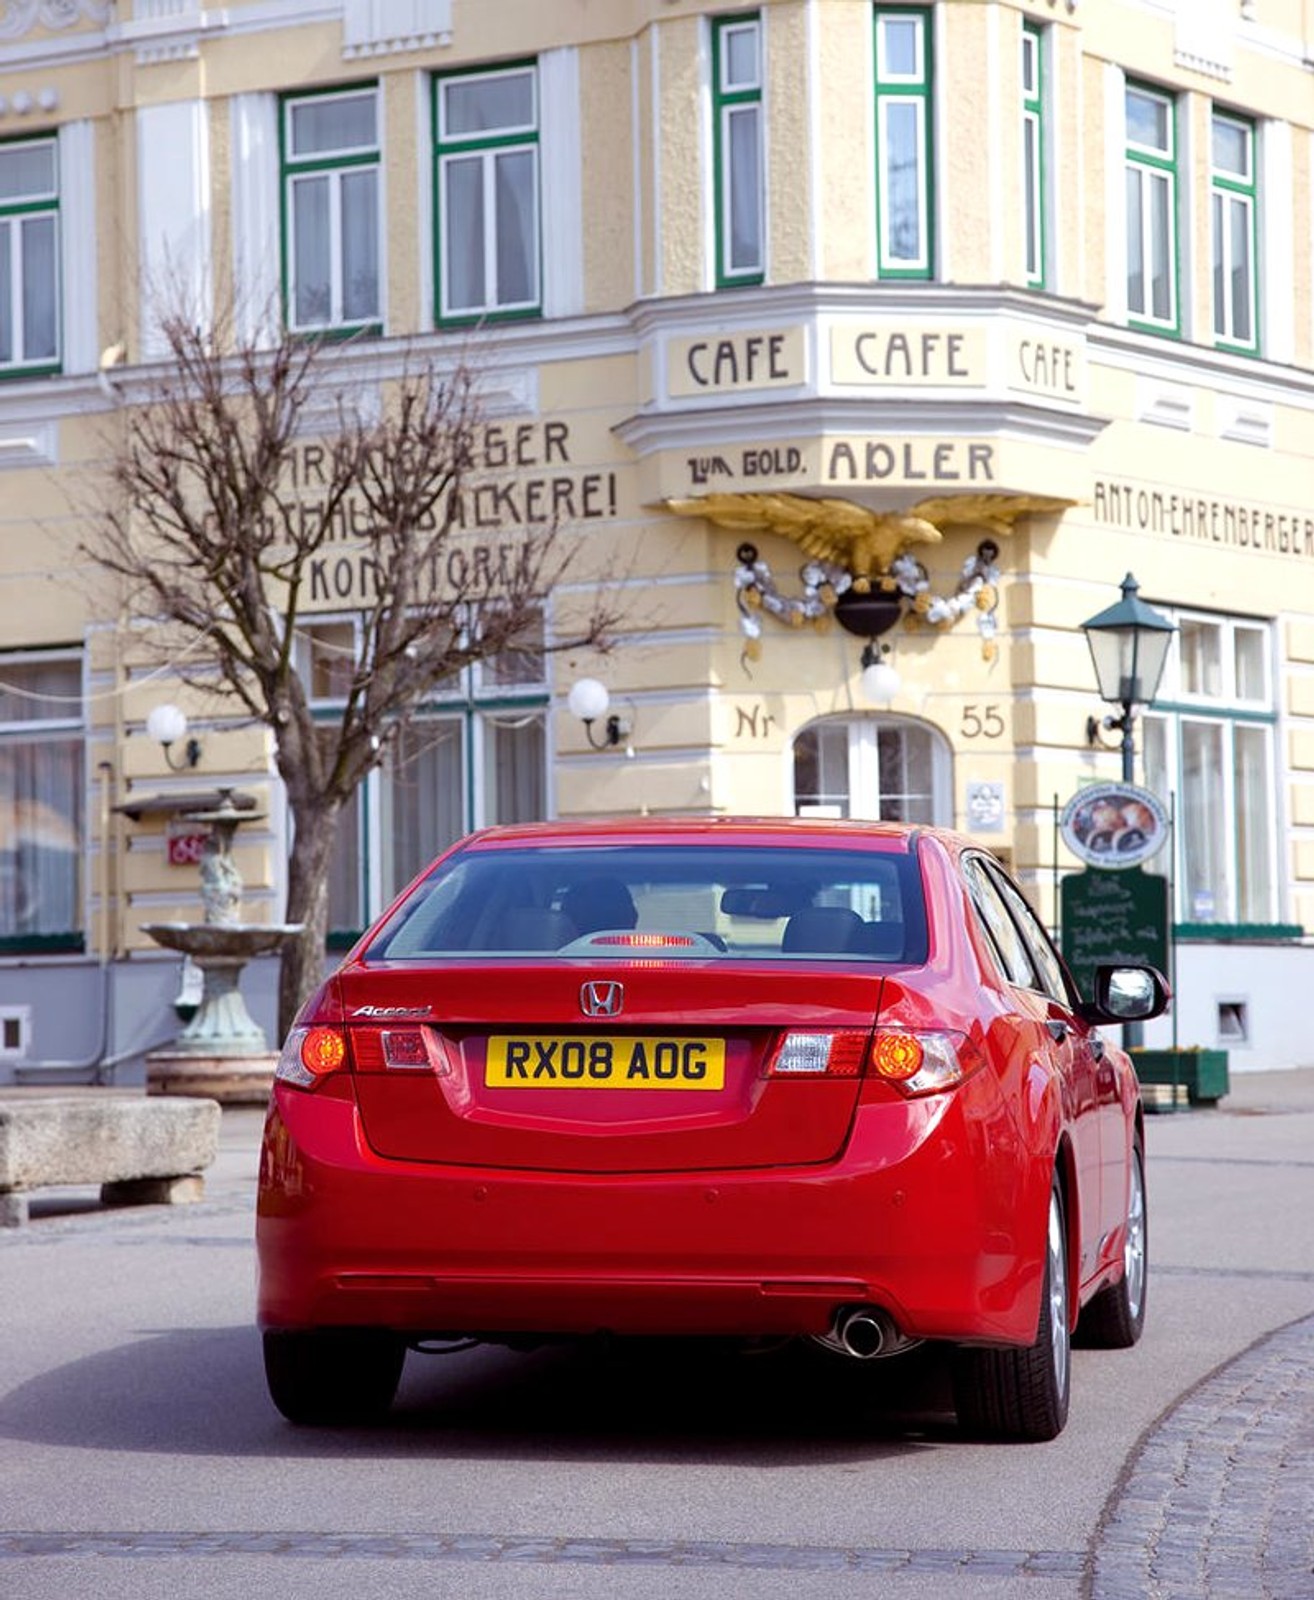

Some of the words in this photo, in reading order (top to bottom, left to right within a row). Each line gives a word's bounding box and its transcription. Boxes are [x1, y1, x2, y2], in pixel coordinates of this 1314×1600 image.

[687, 334, 789, 386] CAFE
[855, 332, 969, 377] CAFE
[1019, 340, 1075, 391] CAFE
[742, 447, 807, 477] GOLD.
[828, 442, 994, 480] ADLER
[735, 704, 775, 738] Nr
[960, 705, 1005, 738] 55
[351, 1005, 433, 1018] Accord
[505, 1040, 613, 1079] RX08
[626, 1041, 708, 1079] AOG
